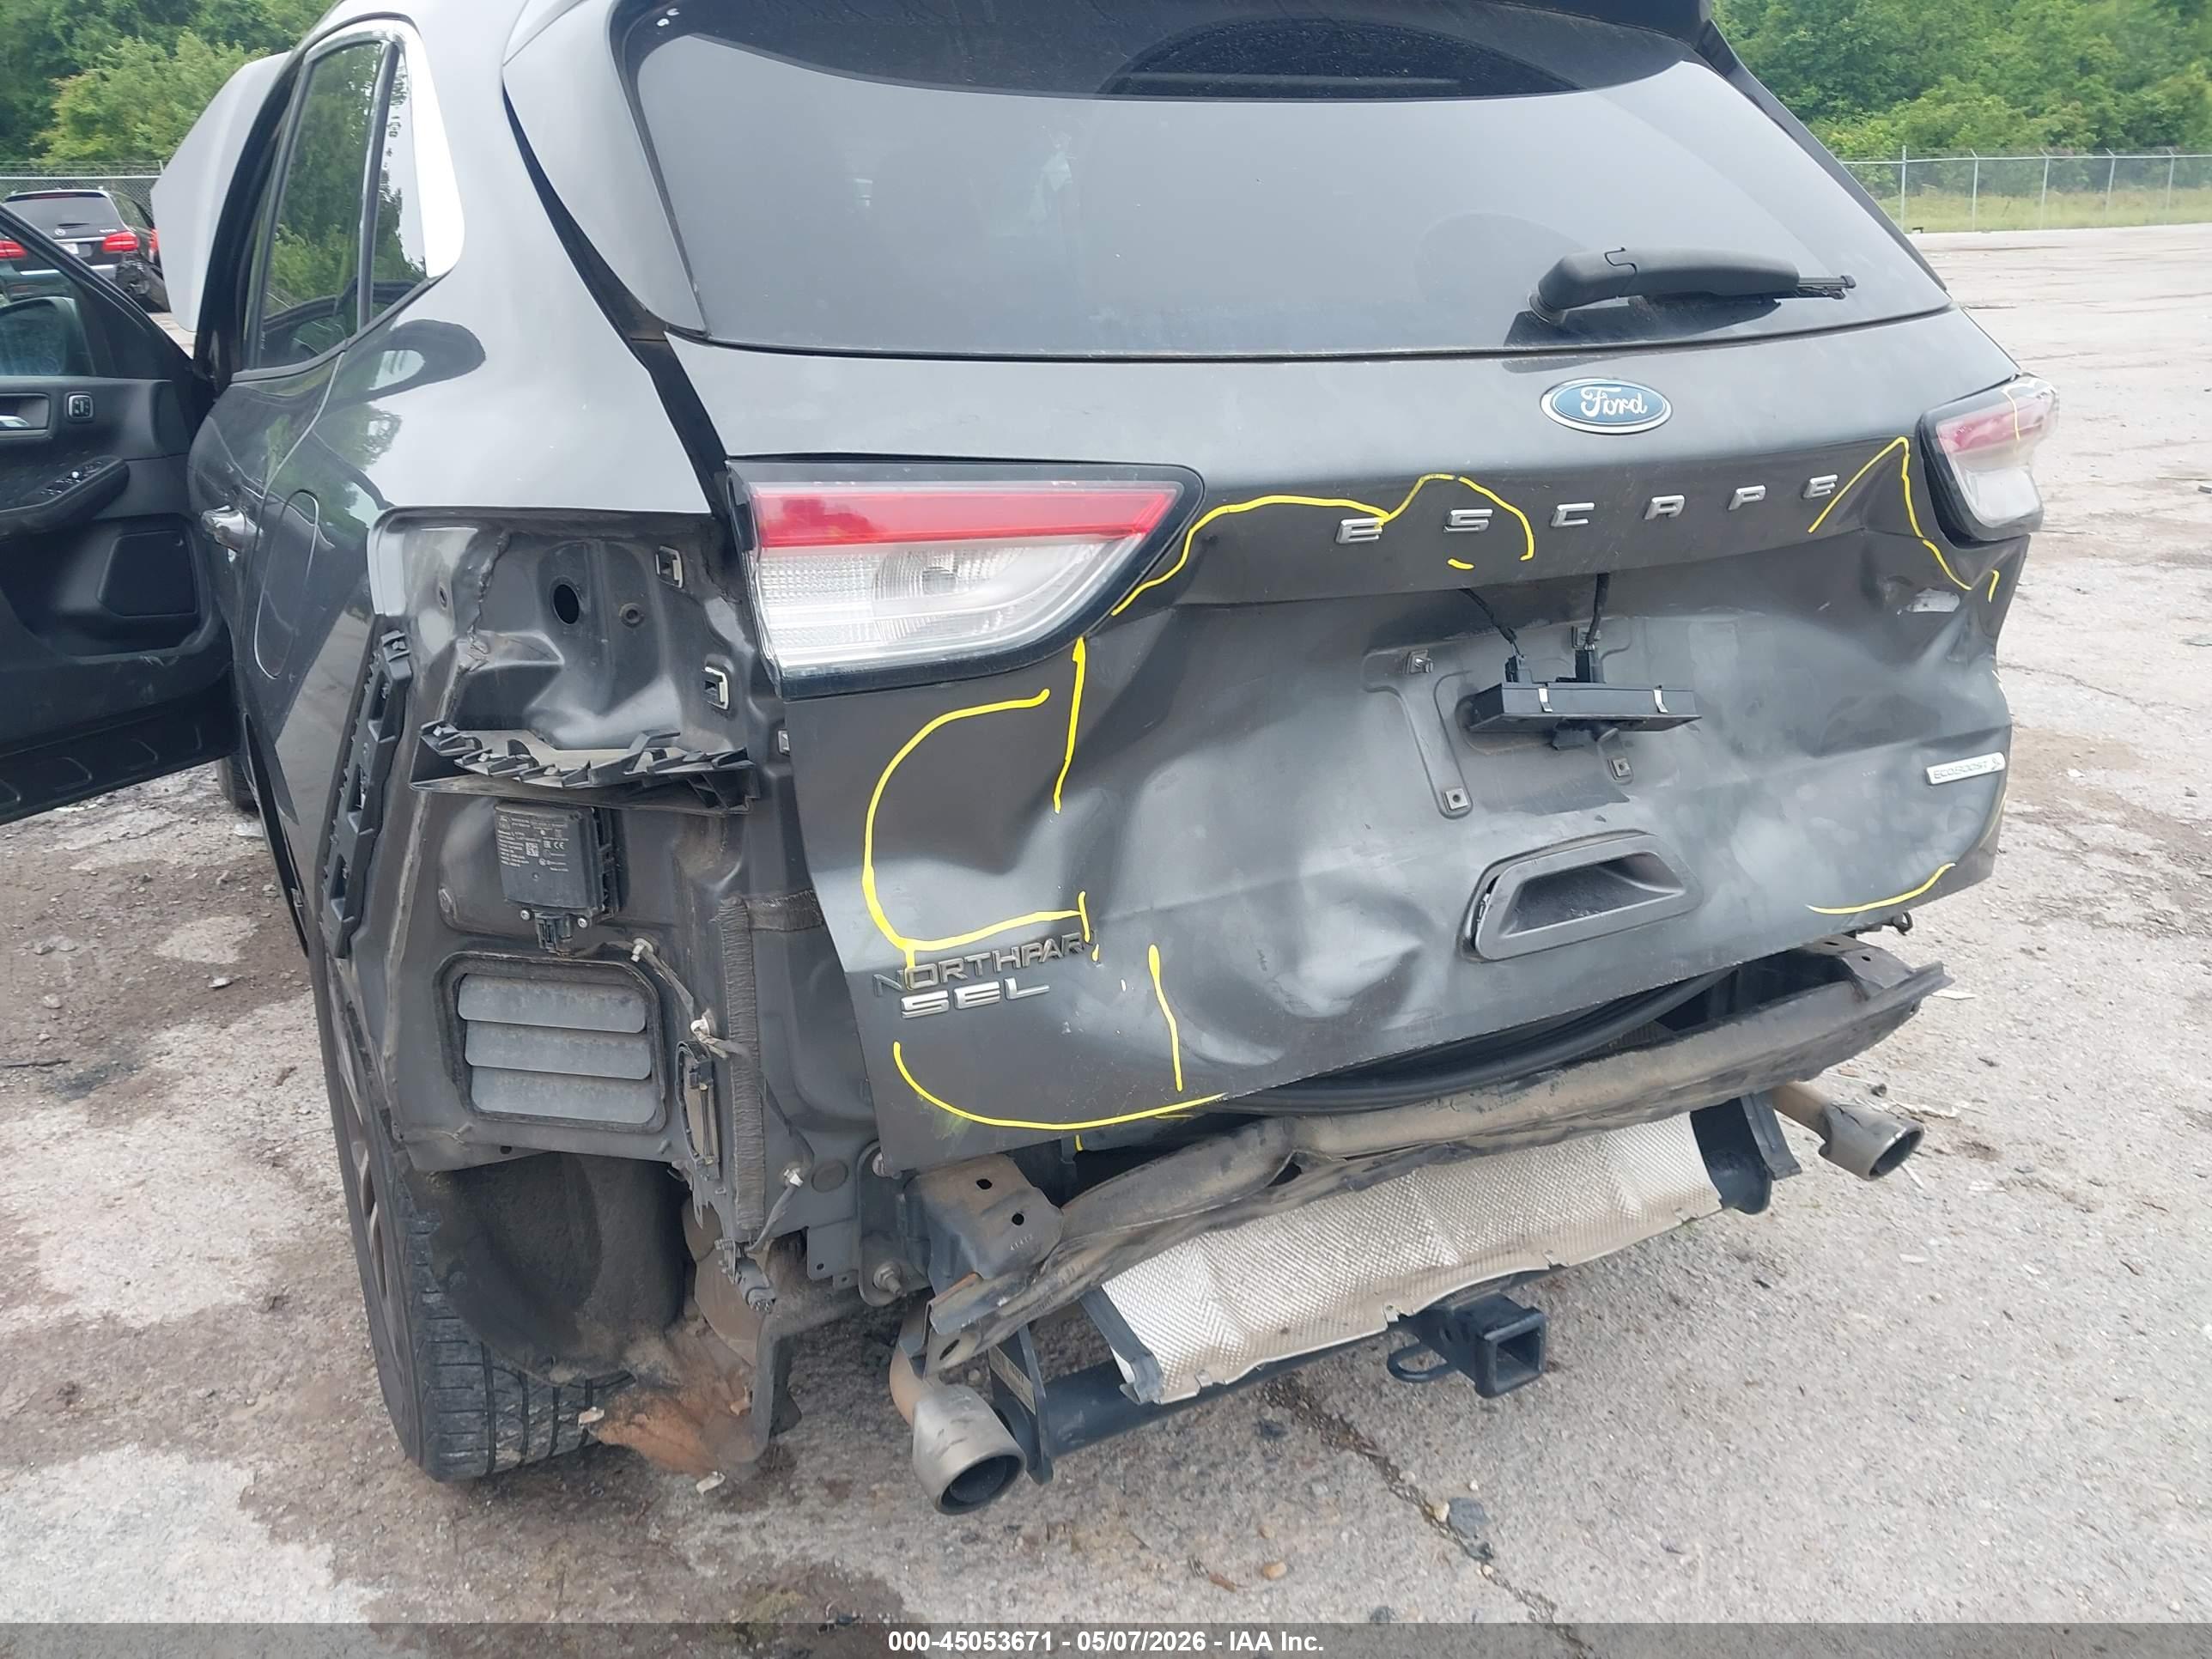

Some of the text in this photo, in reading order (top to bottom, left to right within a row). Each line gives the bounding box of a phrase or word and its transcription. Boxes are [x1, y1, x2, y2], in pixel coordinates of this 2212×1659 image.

[1580, 386, 1648, 417] Ford
[1335, 474, 1839, 544] ESCAPE
[900, 977, 1050, 1019] SEL
